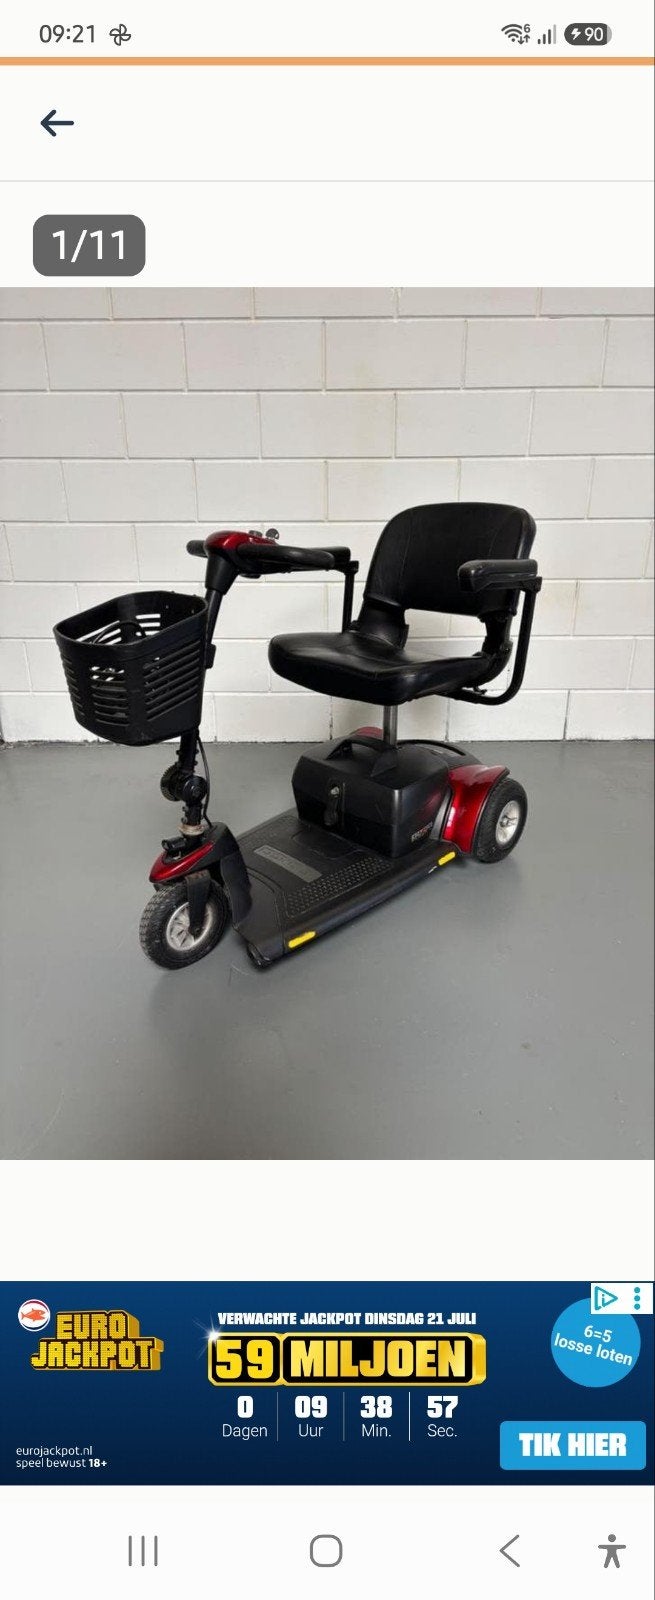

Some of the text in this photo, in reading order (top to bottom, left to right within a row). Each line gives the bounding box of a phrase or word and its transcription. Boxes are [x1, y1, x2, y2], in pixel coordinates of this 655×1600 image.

[39, 25, 96, 43] 09:21
[523, 24, 531, 33] 6
[584, 27, 603, 42] 90
[52, 230, 127, 262] 1/11
[56, 1313, 125, 1339] EURO
[218, 1312, 477, 1325] VERWACHTE JACKPOT DINSDAG 21 JULI
[583, 1325, 613, 1343] 6=5
[31, 1341, 153, 1368] JACKPOT
[554, 1332, 633, 1366] losse loten
[215, 1339, 466, 1379] 59 MILJOEN
[237, 1395, 254, 1418] 0
[294, 1395, 328, 1418] 09
[360, 1395, 393, 1418] 38
[427, 1395, 459, 1418] 57
[222, 1423, 268, 1441] Dagen
[298, 1423, 324, 1437] Uur
[361, 1423, 392, 1437] Min.
[427, 1423, 458, 1437] Sec.
[16, 1445, 93, 1458] eurojackpot.nl
[519, 1432, 627, 1456] TIK HIER
[16, 1458, 108, 1469] speel bewust 18+
